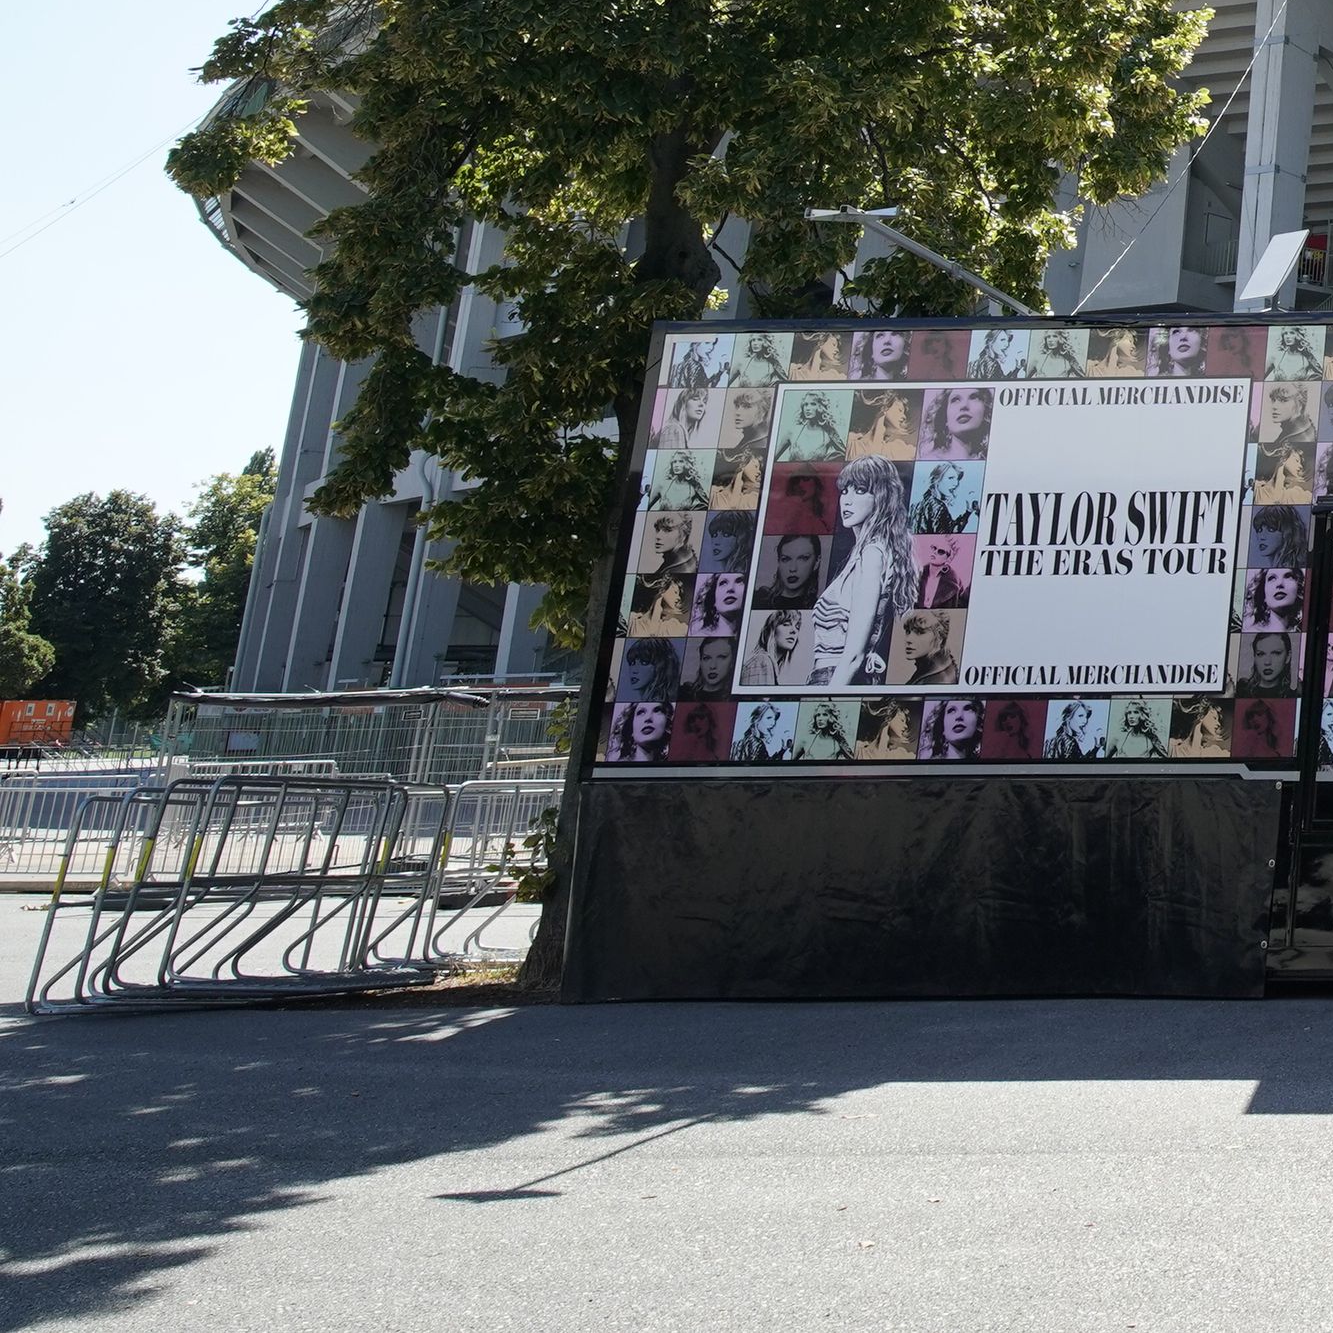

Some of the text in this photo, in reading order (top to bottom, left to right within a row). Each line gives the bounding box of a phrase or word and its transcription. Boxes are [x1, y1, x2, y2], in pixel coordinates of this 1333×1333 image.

[998, 385, 1245, 407] OFFICIAL MERCHANDISE
[985, 489, 1234, 546] TAYLOR SWIFT
[980, 547, 1228, 577] THE ERAS TOUR
[965, 664, 1218, 686] OFFICIAL MERCHANDISE
